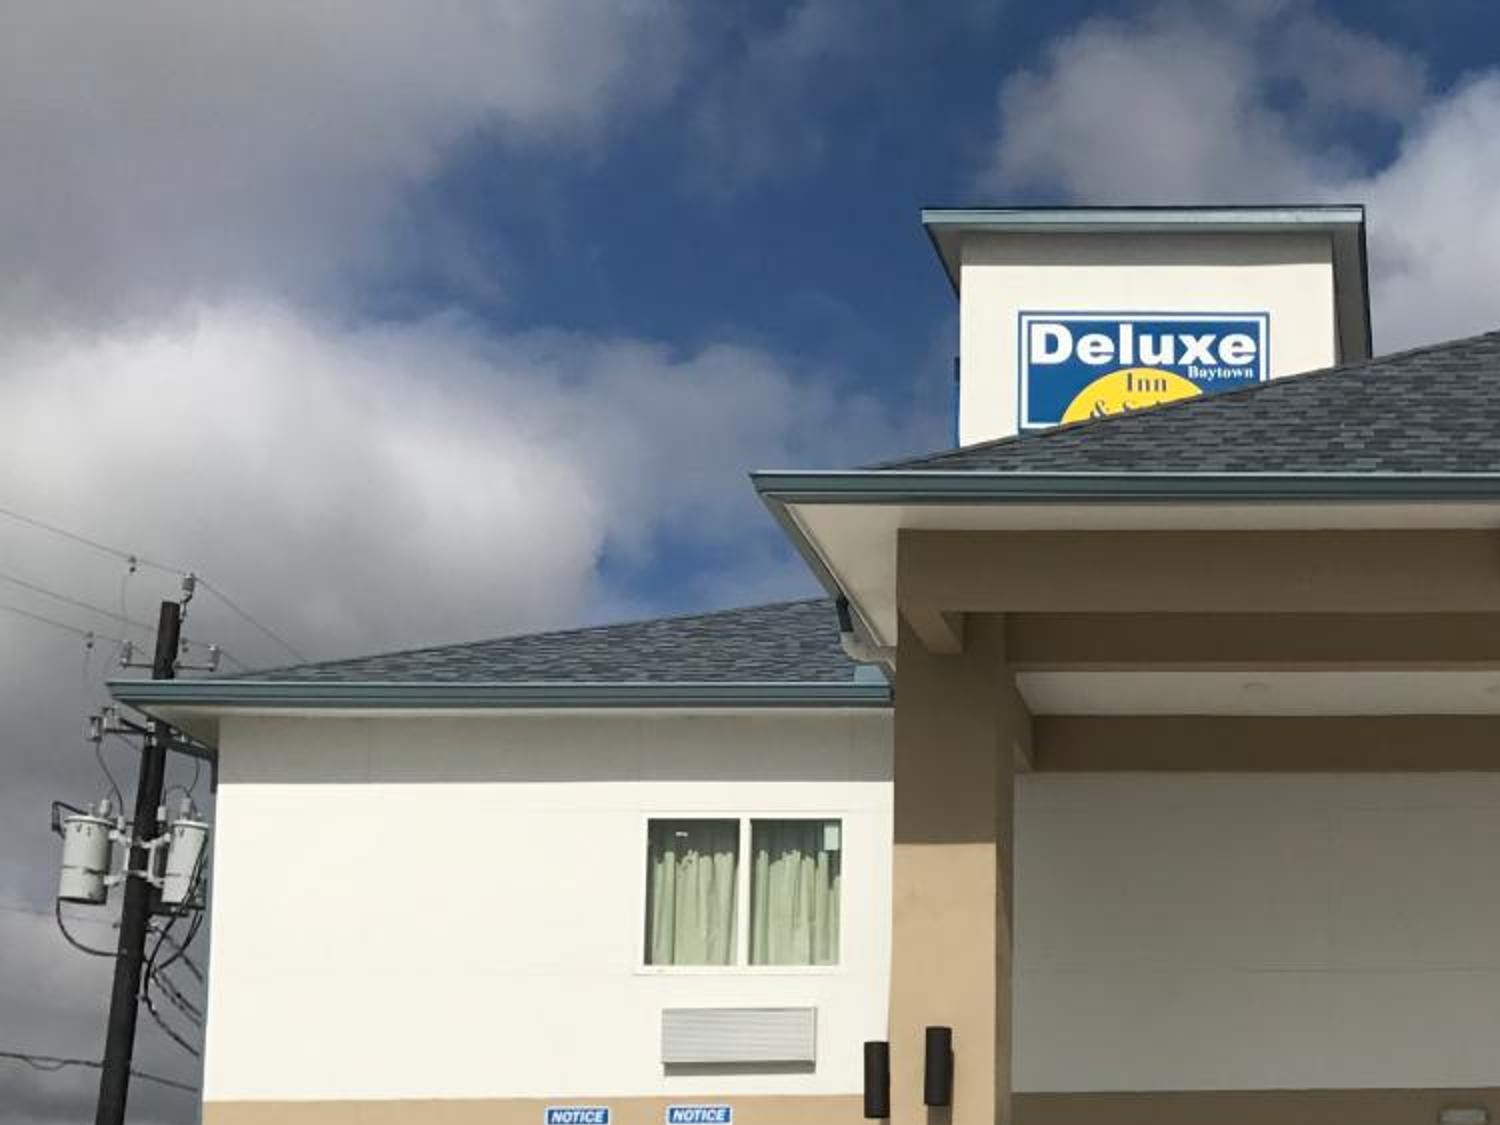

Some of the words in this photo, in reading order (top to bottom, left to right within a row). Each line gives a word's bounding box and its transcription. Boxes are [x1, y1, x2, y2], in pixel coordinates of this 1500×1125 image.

[1030, 323, 1257, 365] Deluxe
[1127, 372, 1167, 392] Inn
[1188, 365, 1254, 382] Baytown
[551, 1110, 605, 1123] NOTICE
[672, 1109, 726, 1121] NOTICE
